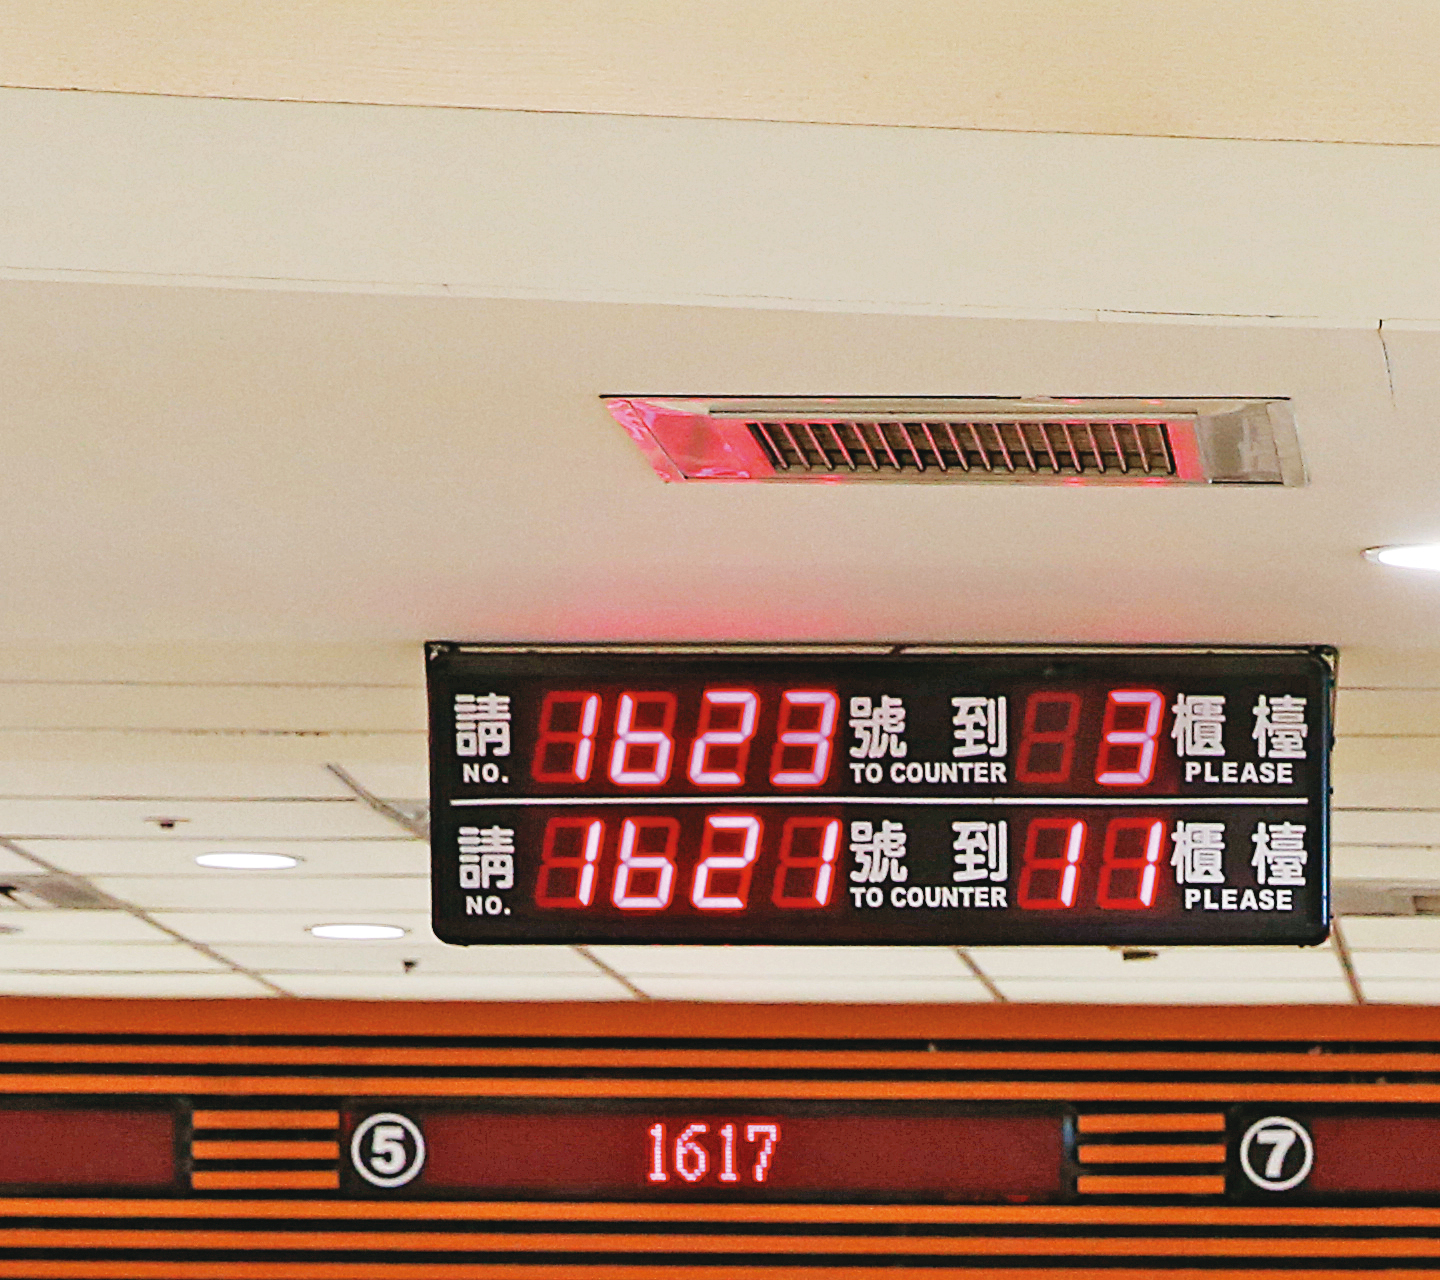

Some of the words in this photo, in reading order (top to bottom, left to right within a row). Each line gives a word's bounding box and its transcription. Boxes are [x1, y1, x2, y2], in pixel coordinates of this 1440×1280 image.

[454, 693, 511, 757] 請
[573, 688, 838, 786] 1623
[1098, 688, 1161, 786] 3
[463, 763, 509, 783] NO.
[850, 763, 883, 784] TO
[890, 763, 1007, 784] COUNTER
[1185, 761, 1293, 784] PLEASE
[457, 825, 515, 889] 請
[573, 816, 838, 910] 1621
[1057, 820, 1161, 909] 11
[466, 896, 510, 916] NO.
[850, 887, 883, 908] TO
[890, 887, 1007, 909] COUNTER
[1184, 889, 1294, 910] PLEASE
[647, 1123, 780, 1183] 1617
